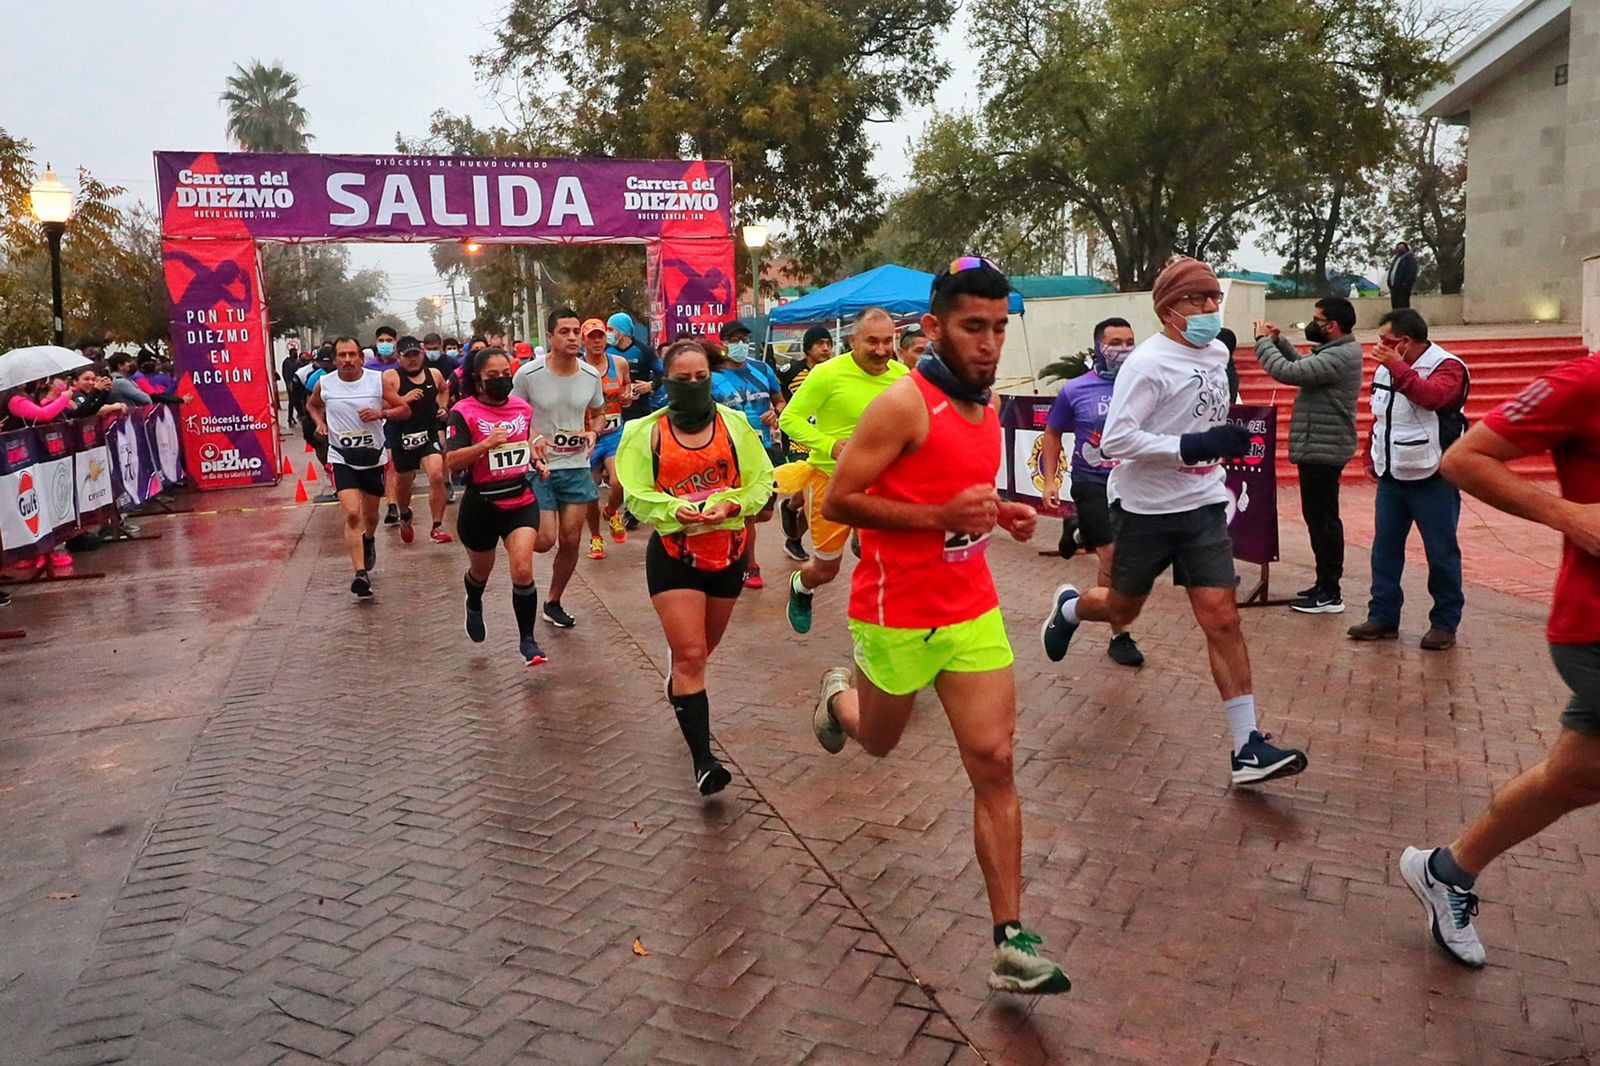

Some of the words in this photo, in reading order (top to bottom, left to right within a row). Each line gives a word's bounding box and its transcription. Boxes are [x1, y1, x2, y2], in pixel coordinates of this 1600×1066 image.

[439, 159, 452, 167] DE
[459, 160, 497, 168] NUEVO
[504, 160, 548, 169] LAREDO
[178, 169, 255, 186] Carrera
[259, 171, 289, 186] del
[626, 176, 688, 190] Carrera
[691, 177, 716, 190] del
[176, 187, 294, 209] DIEZMO
[326, 172, 595, 227] SALIDA
[624, 192, 719, 211] DIEZMO
[194, 210, 220, 218] NUEVO
[186, 310, 217, 324] PON
[226, 308, 246, 322] TU
[677, 304, 701, 317] PON
[708, 303, 724, 316] TU
[187, 328, 249, 344] DIEZMO
[210, 350, 231, 364] EN
[193, 367, 253, 385] ACCIÓN
[201, 415, 240, 425] Diócesis
[242, 414, 255, 422] de
[202, 425, 233, 434] Nuevo
[234, 422, 268, 432] Laredo
[340, 435, 373, 447] 075
[220, 449, 239, 460] TU
[494, 449, 525, 467] 117
[201, 457, 261, 473] DIEZMO
[19, 493, 38, 517] Gulf
